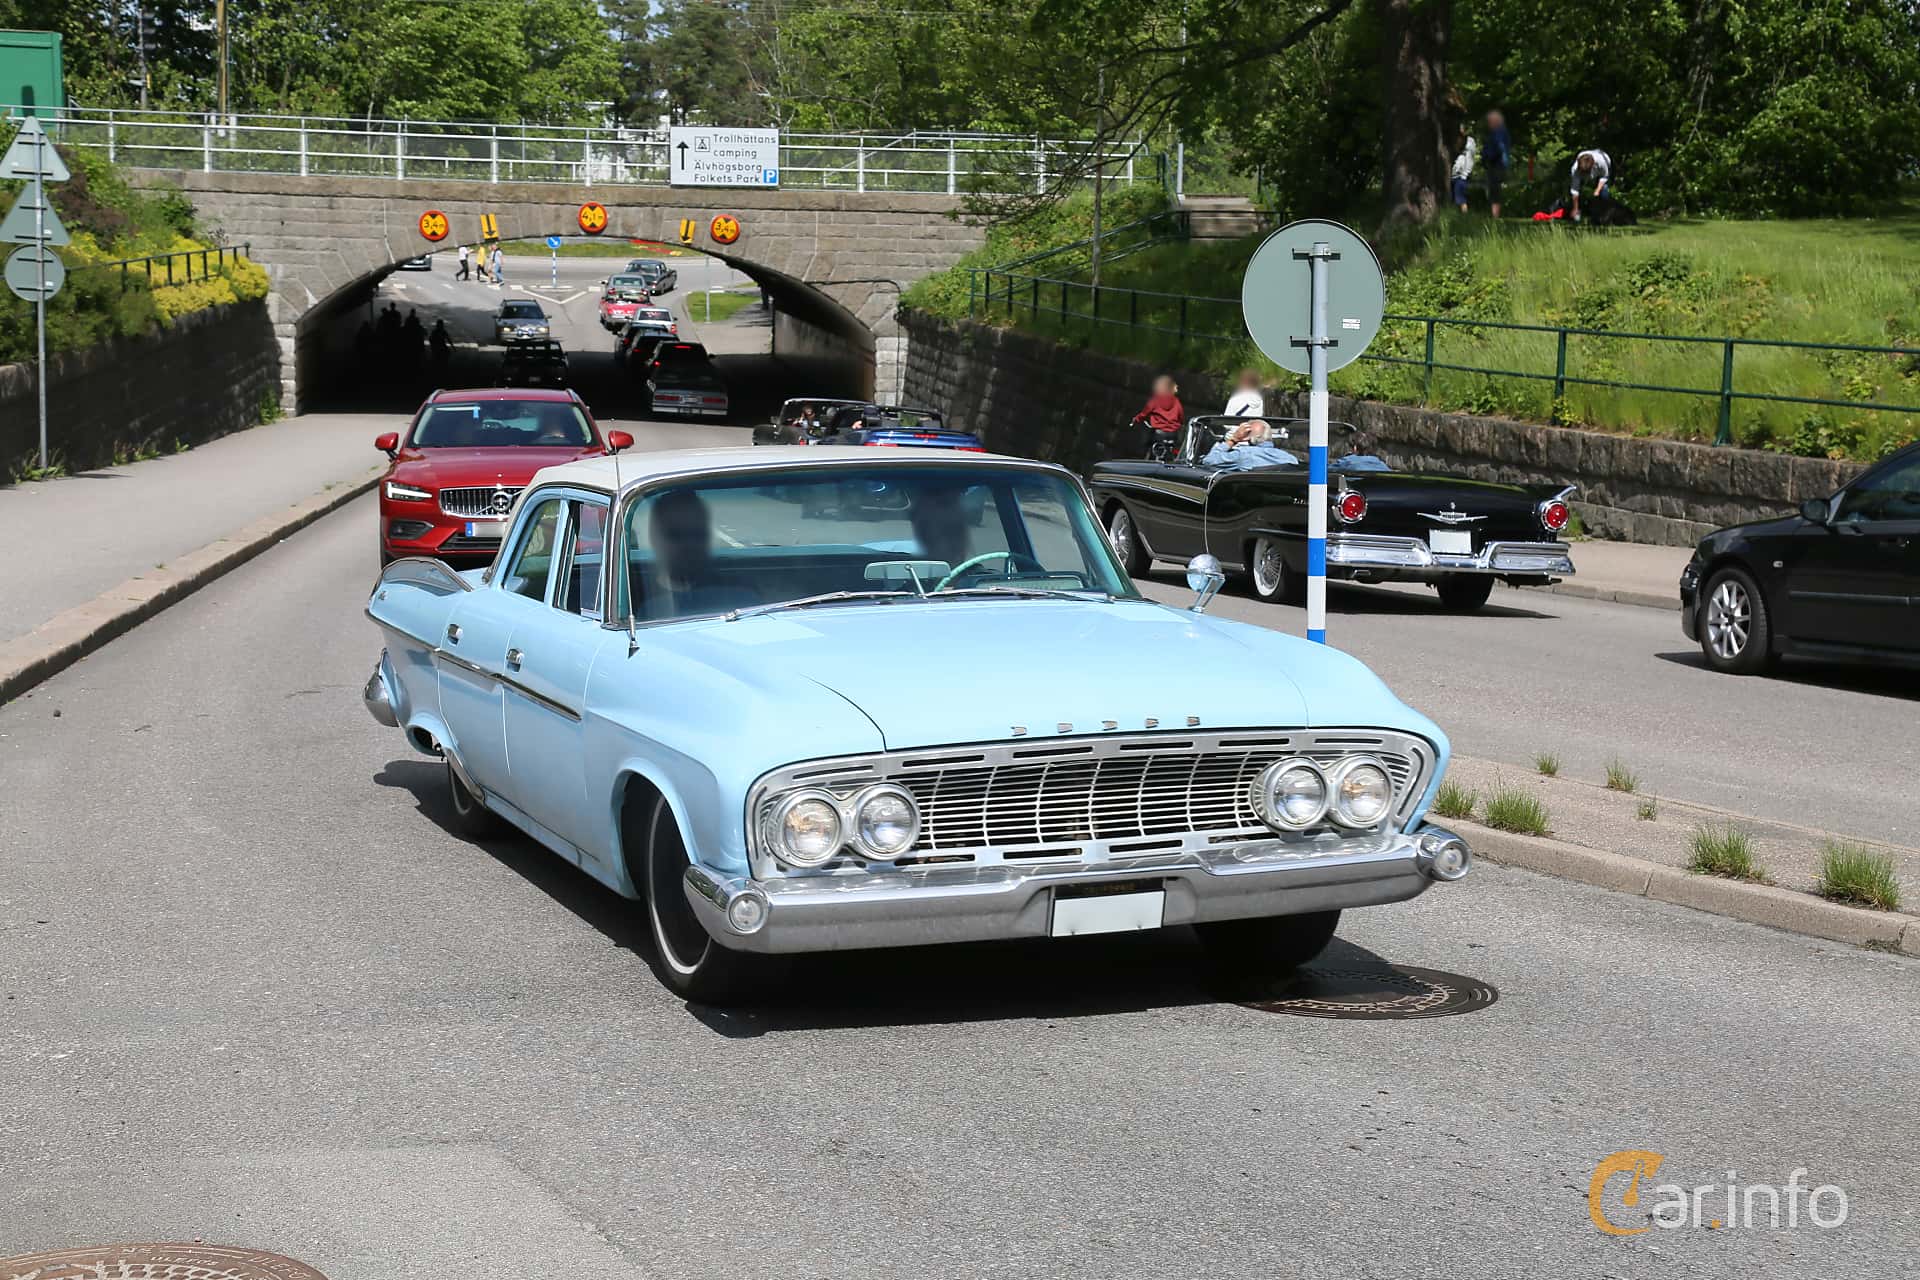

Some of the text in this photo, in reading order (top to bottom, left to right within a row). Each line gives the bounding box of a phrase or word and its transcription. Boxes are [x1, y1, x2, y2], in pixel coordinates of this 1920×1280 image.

[713, 134, 776, 144] Trollhättans
[713, 148, 758, 159] camping
[694, 160, 762, 173] Älvhögsborg
[694, 173, 761, 183] Folkets Park
[766, 170, 776, 183] P
[1010, 715, 1201, 738] DODGE
